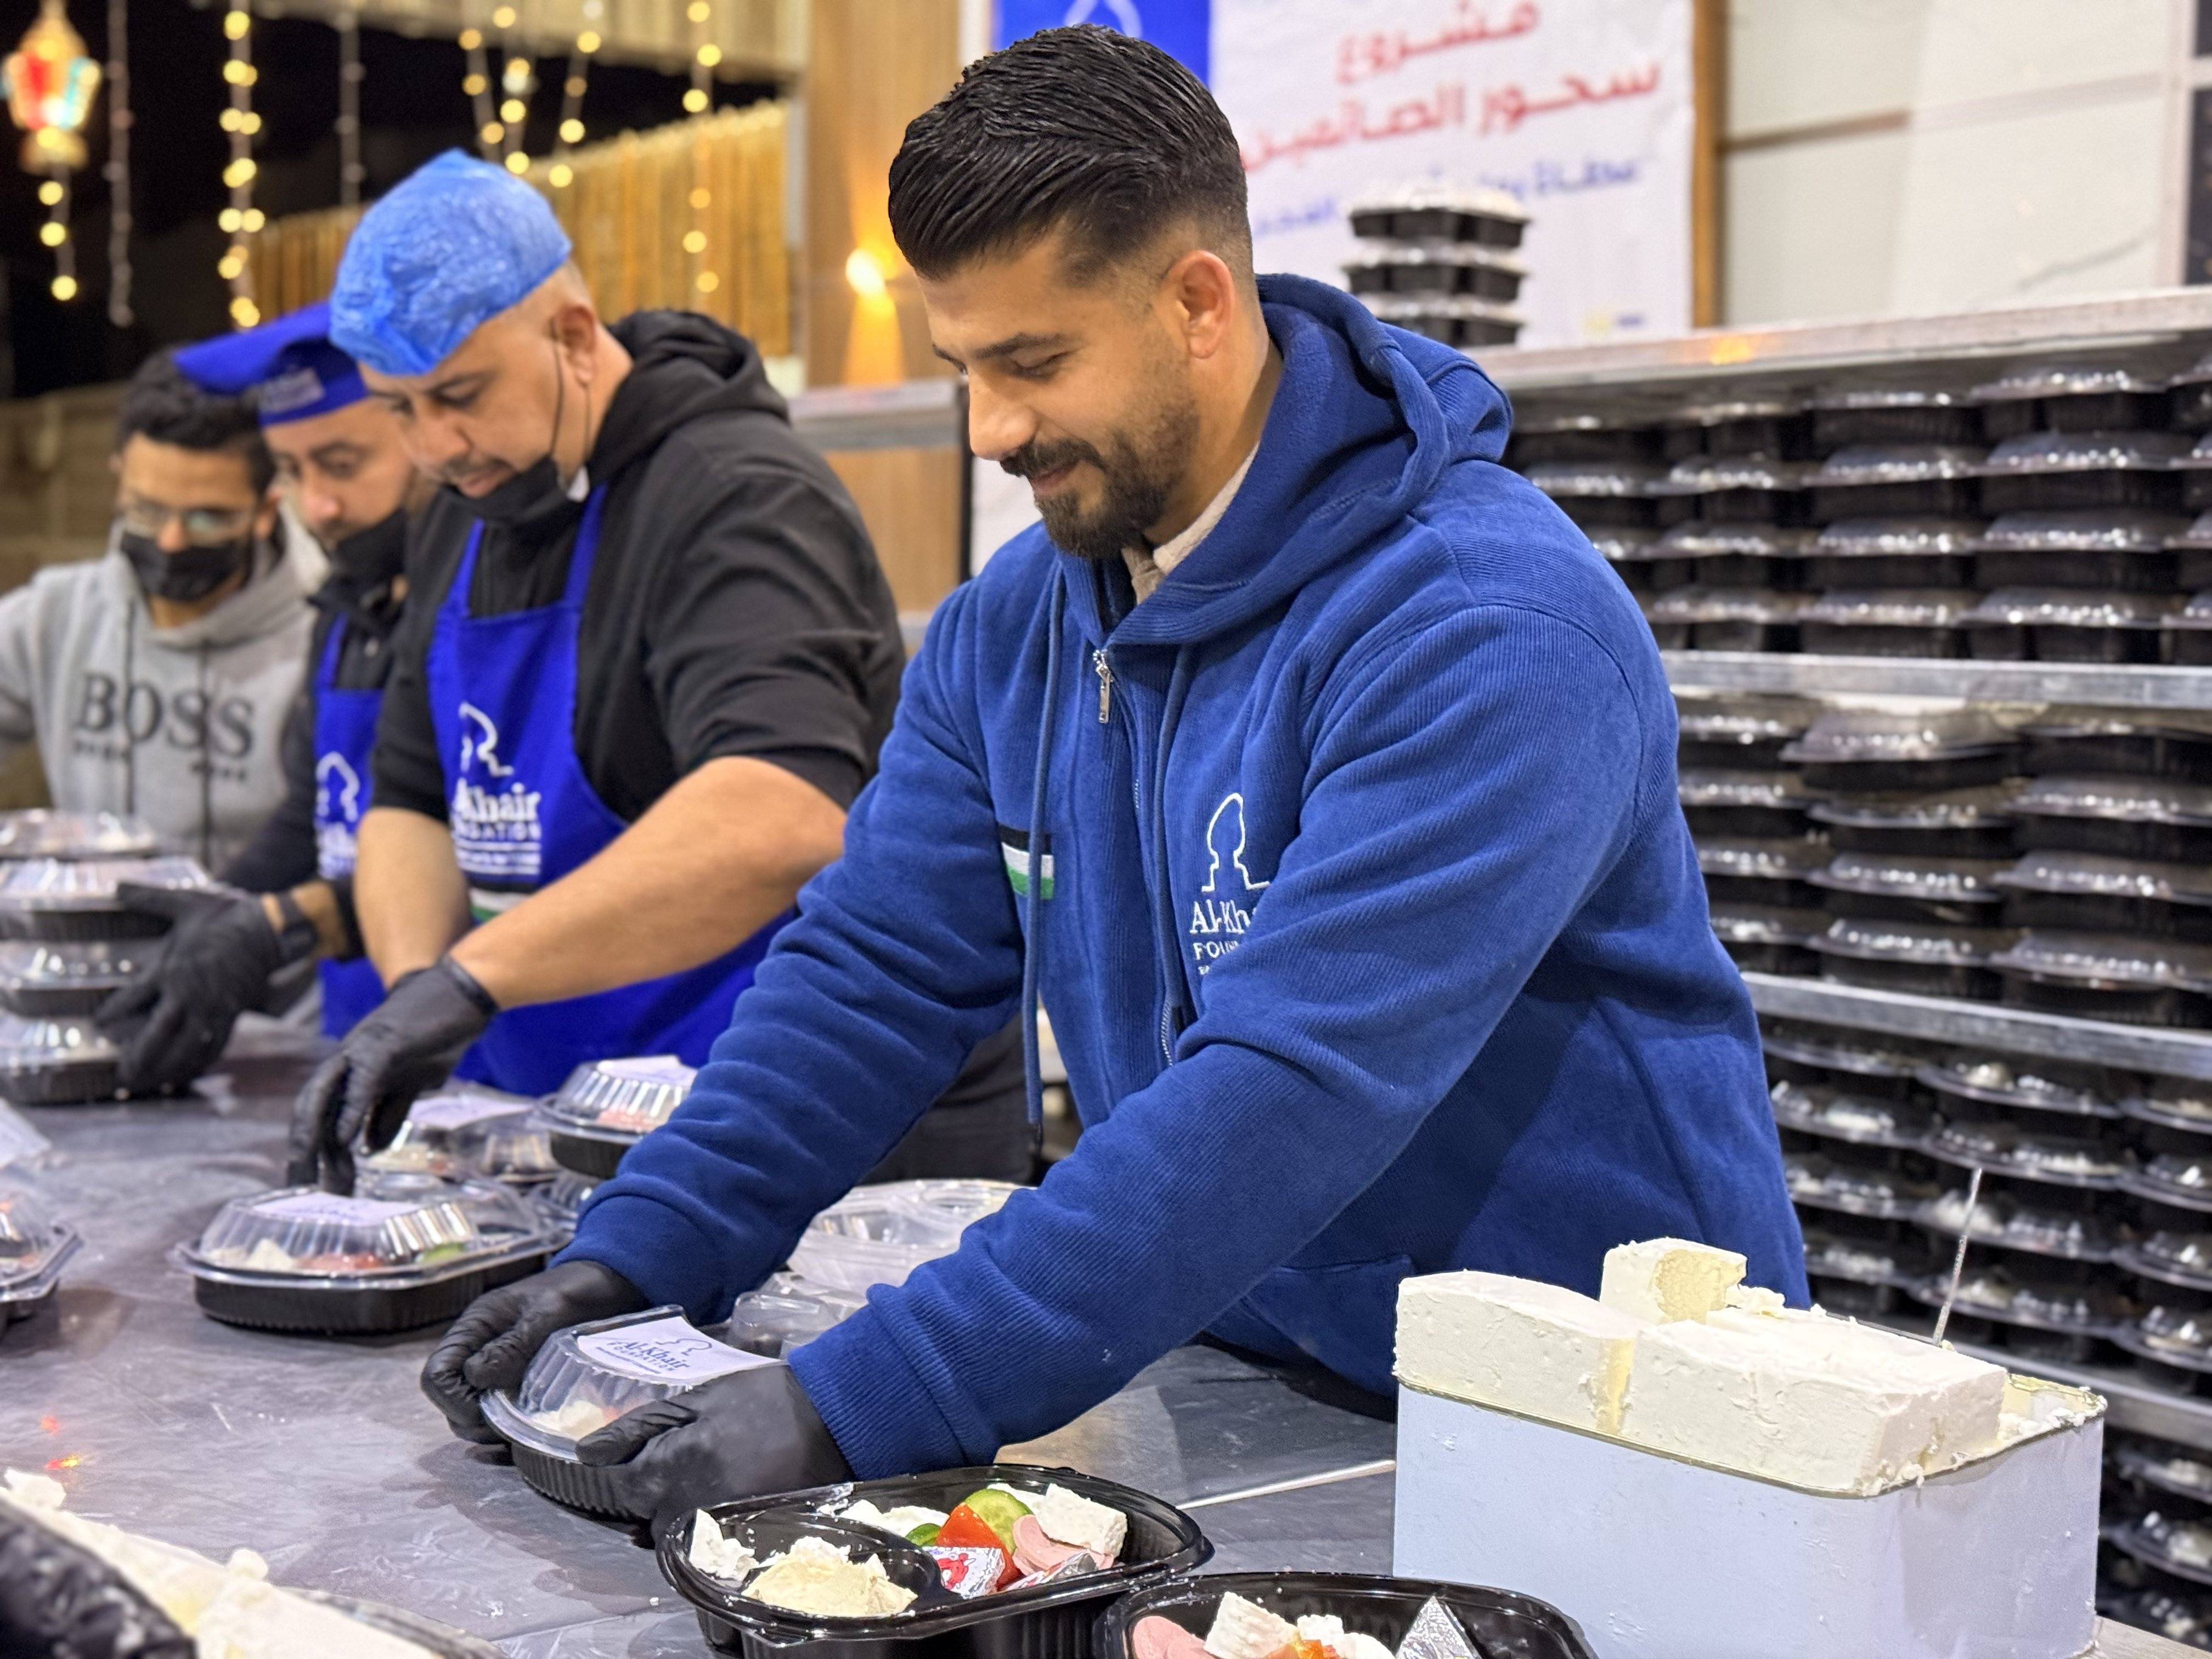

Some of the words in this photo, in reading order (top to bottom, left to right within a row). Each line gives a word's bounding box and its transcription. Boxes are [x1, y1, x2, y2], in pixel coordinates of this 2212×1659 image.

[1335, 0, 1540, 84] مشروع
[1480, 61, 1662, 135] سحور
[76, 673, 254, 759] BOSS
